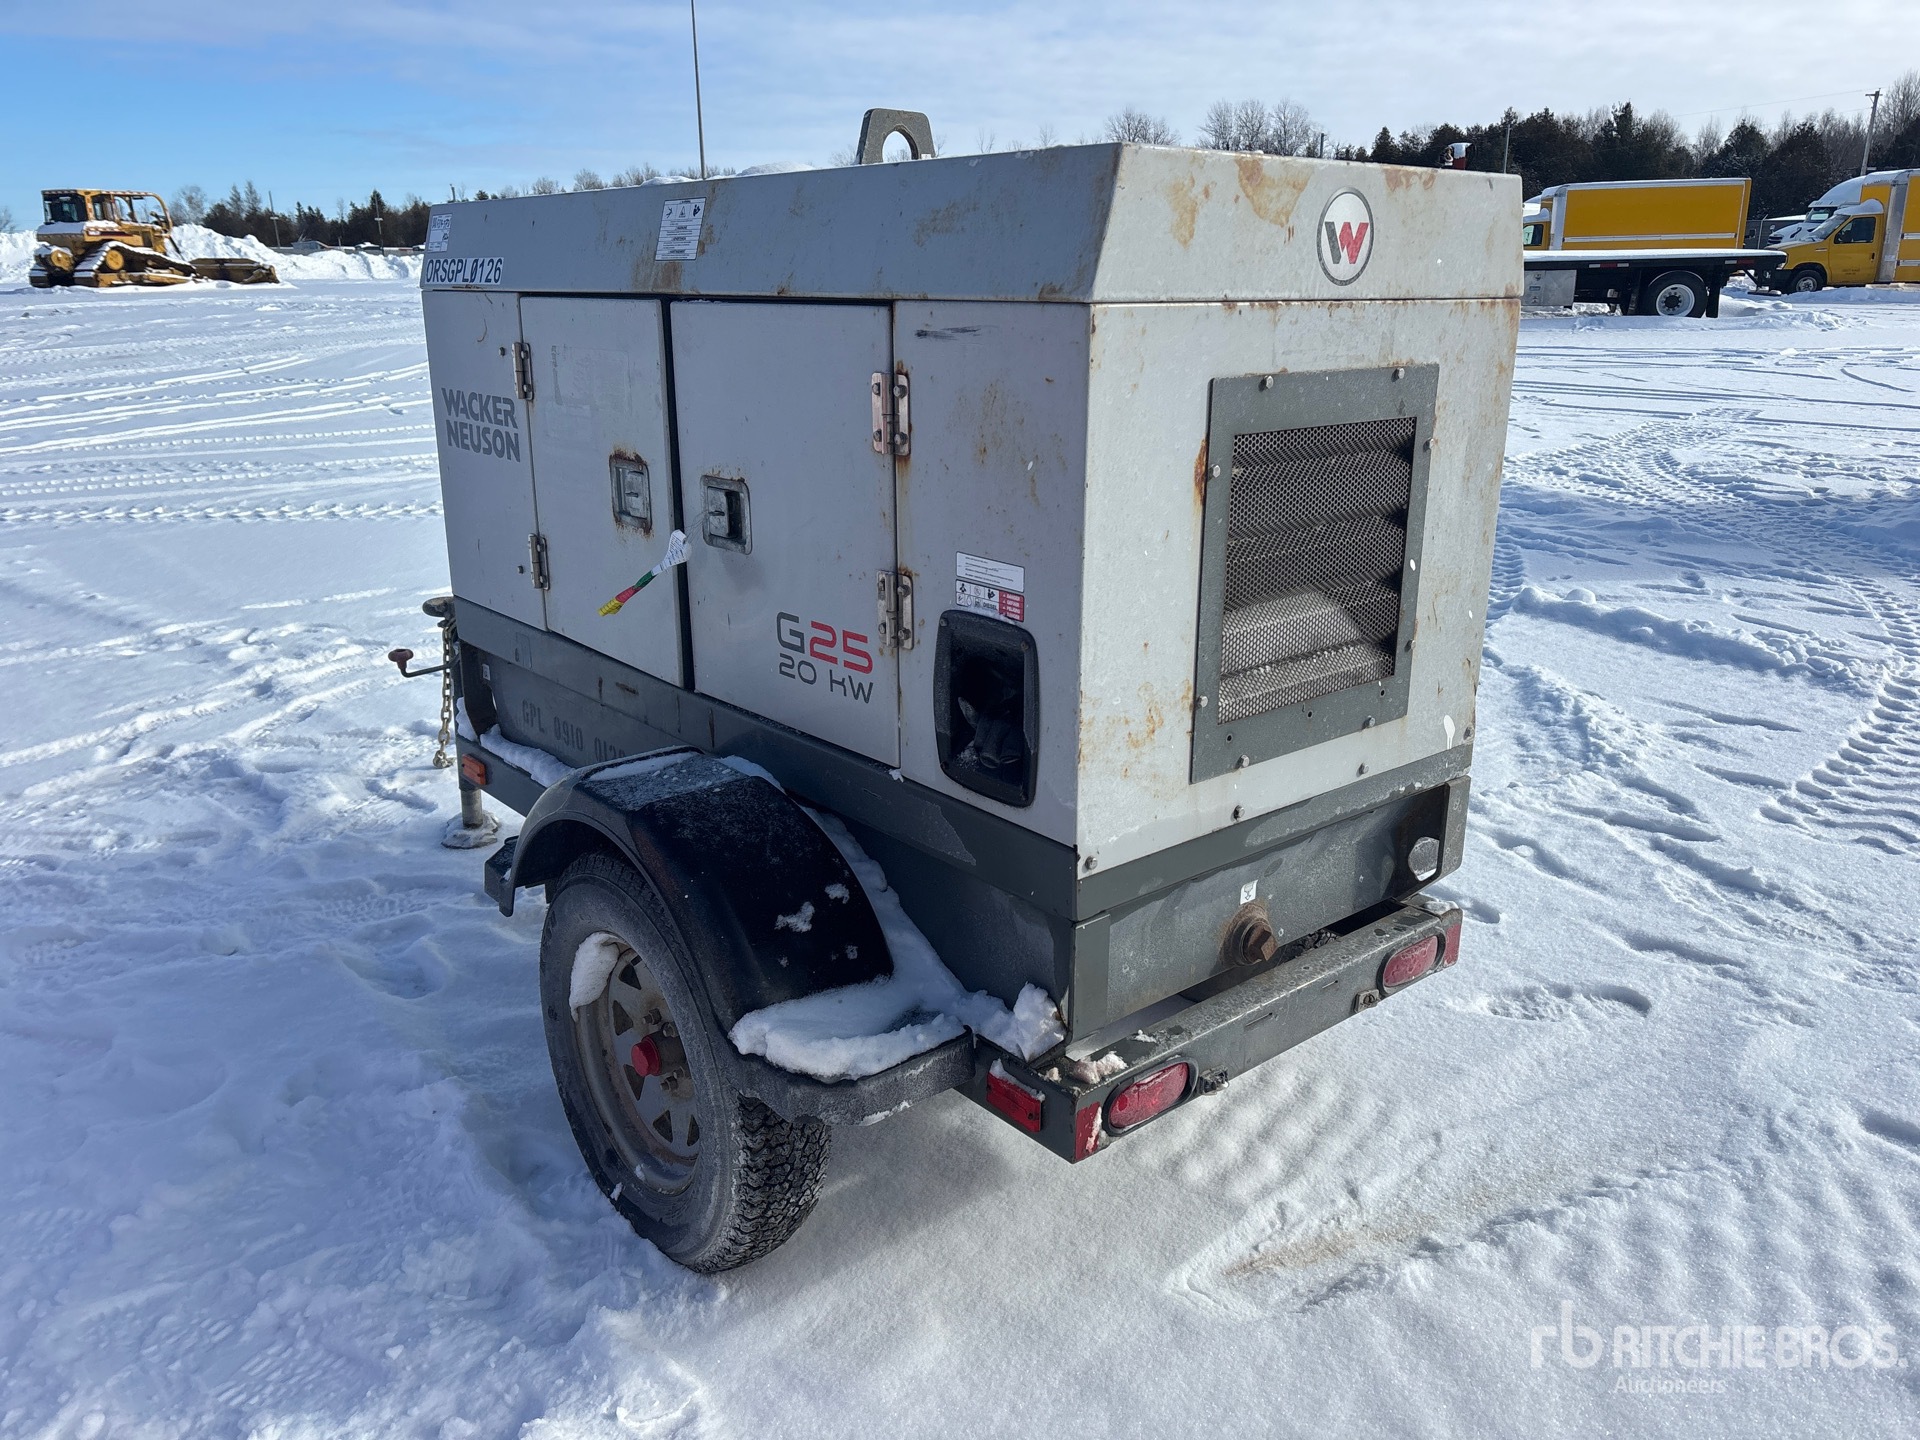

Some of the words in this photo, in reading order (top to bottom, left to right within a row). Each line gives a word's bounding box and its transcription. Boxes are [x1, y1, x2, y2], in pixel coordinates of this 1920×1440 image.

[441, 387, 518, 429] WACKER
[446, 419, 520, 463] NEUSON
[776, 611, 873, 674] G25
[779, 653, 817, 685] 20
[522, 698, 545, 733] GPL
